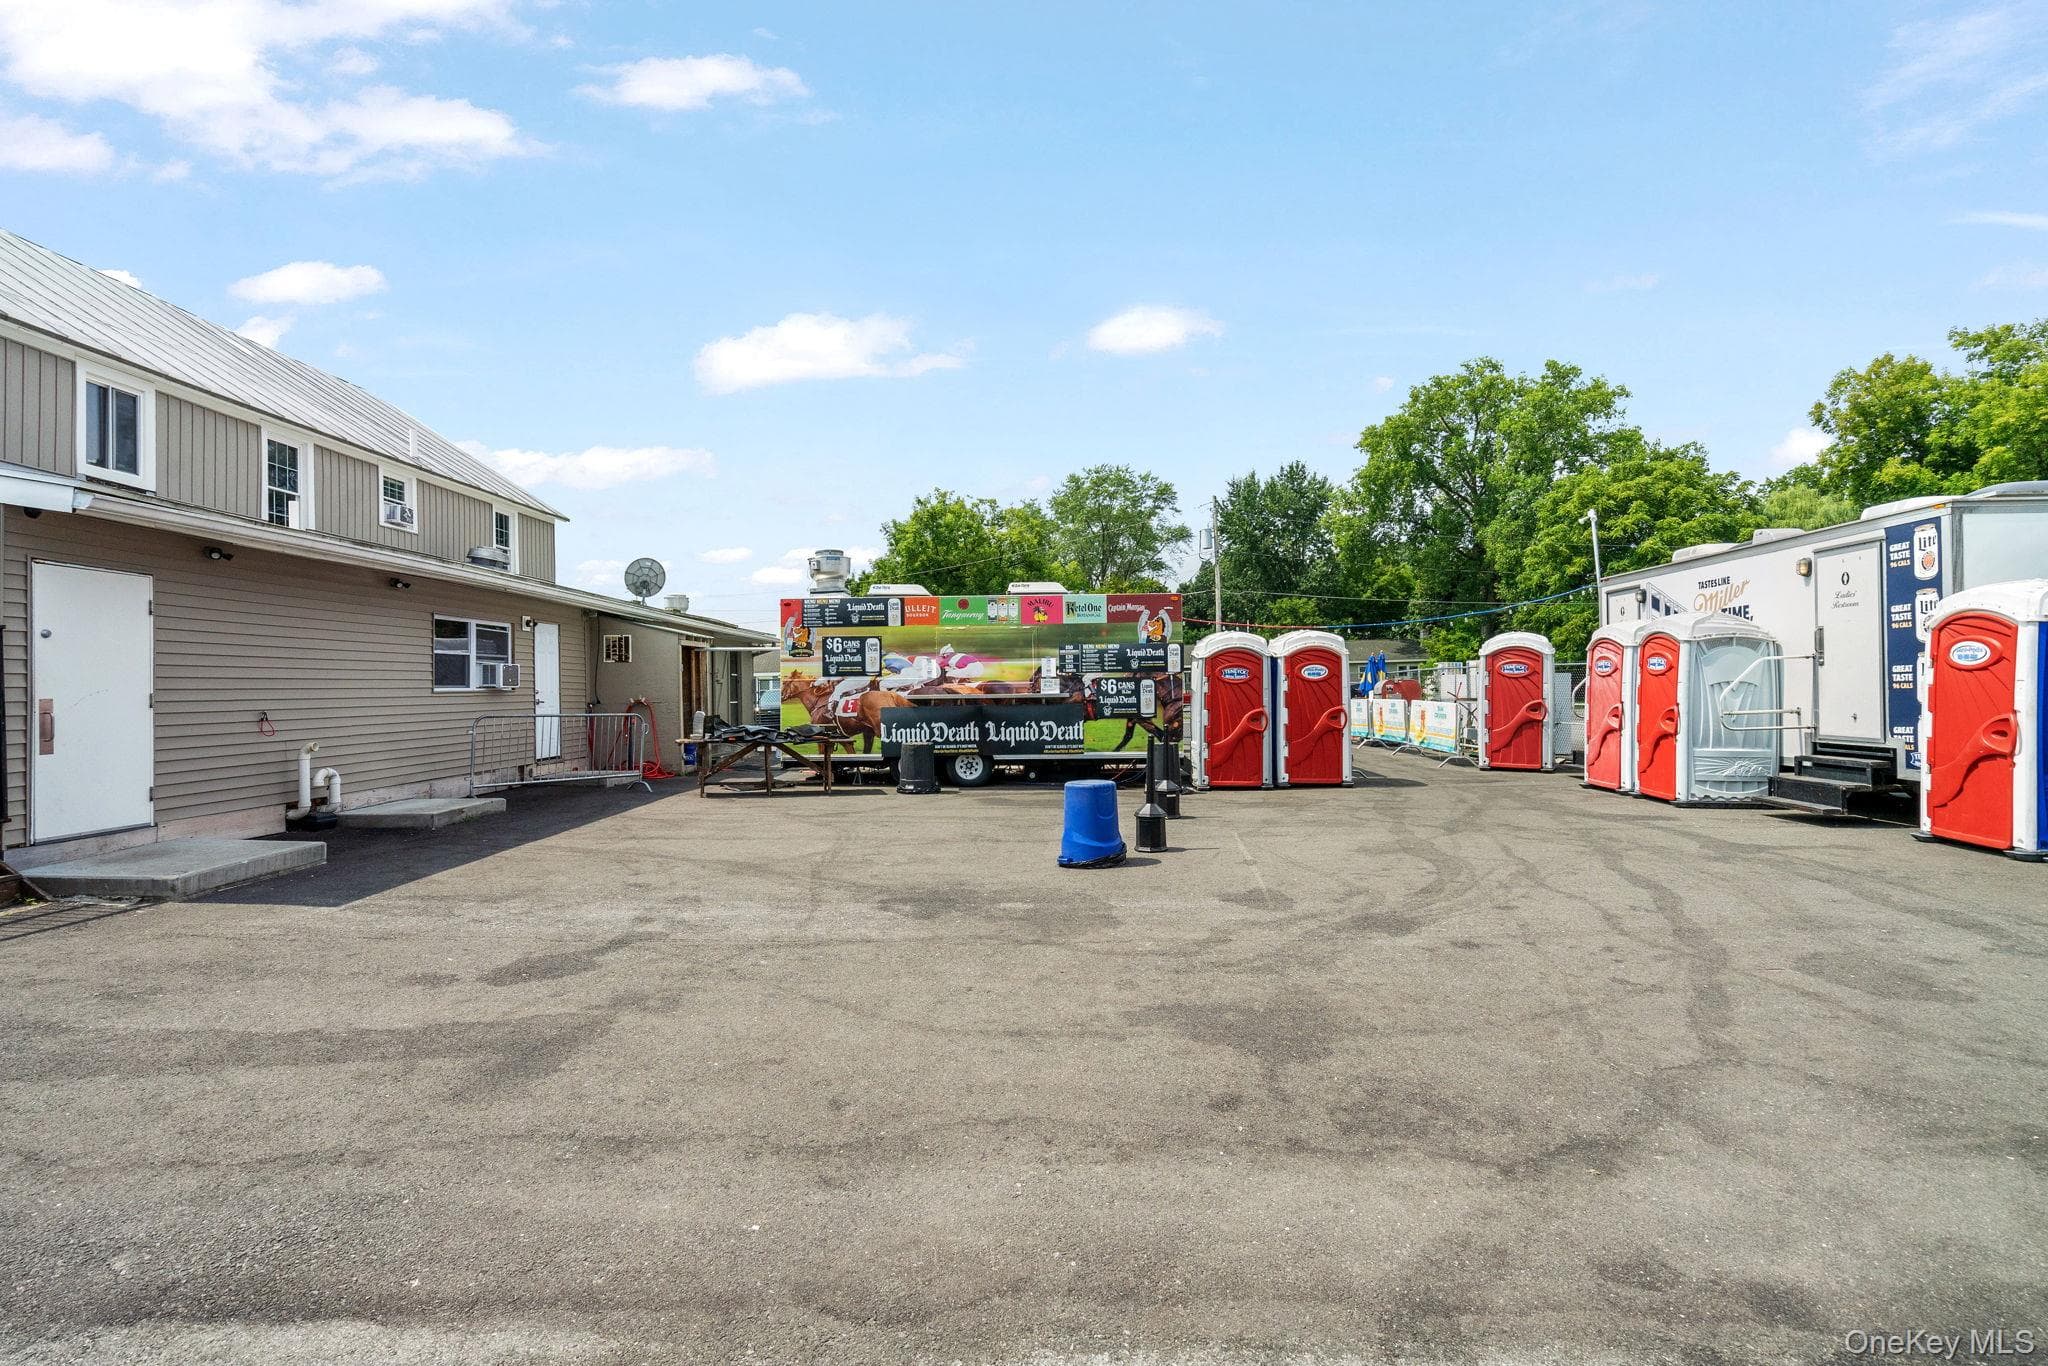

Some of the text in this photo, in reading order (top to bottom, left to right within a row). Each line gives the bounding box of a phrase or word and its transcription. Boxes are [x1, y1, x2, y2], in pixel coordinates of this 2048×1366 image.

[1889, 541, 1910, 552] GREAT
[1919, 535, 1937, 551] Lite
[1889, 550, 1911, 560] TASTE
[1898, 559, 1911, 567] CALS
[1698, 576, 1731, 590] TASTES LIKE
[1694, 579, 1751, 613] Miller
[846, 602, 885, 613] Liquid Death
[1027, 598, 1055, 608] MALIBU
[1108, 603, 1127, 613] Captain
[1891, 603, 1912, 613] GREAT
[905, 604, 937, 614] ULLEIT
[1065, 602, 1102, 615] Ketel One
[1891, 612, 1913, 621] TASTE
[826, 637, 843, 653] $6
[1126, 648, 1165, 658] Liquid Death
[825, 654, 863, 664] Liquid Death
[1892, 664, 1914, 673] GREAT
[1892, 673, 1914, 682] TASTE
[1100, 679, 1135, 695] $6 CANS
[1099, 695, 1137, 706] Liquid Death
[847, 700, 854, 713] 5
[880, 720, 980, 745] Liquid Death
[984, 720, 1039, 747] Liquid
[1893, 726, 1914, 734] GREAT
